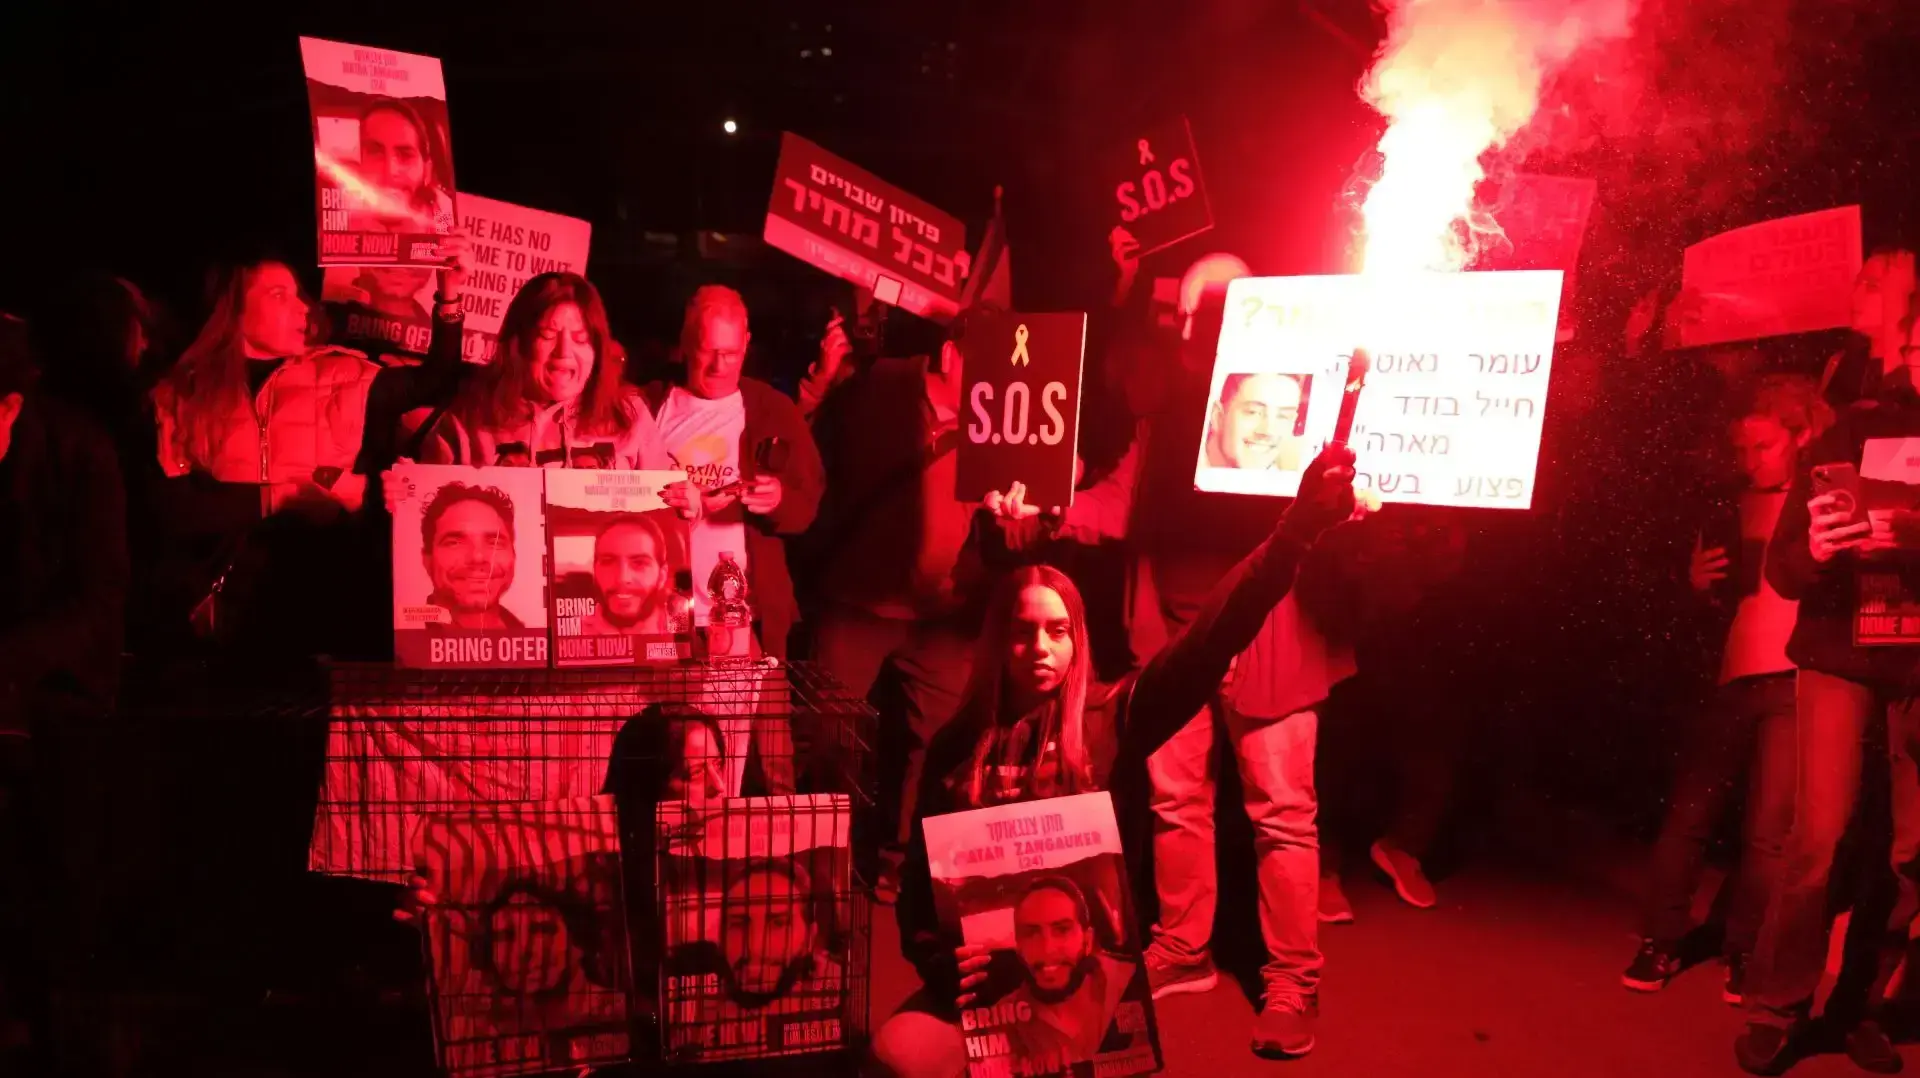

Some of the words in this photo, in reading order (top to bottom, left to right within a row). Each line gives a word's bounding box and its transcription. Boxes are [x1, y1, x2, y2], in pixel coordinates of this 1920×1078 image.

[810, 164, 884, 213] שבויים
[1116, 157, 1195, 222] S.O.S
[464, 216, 487, 238] HE
[490, 221, 524, 246] HAS
[528, 230, 551, 252] NO
[889, 204, 940, 243] פדיון
[505, 250, 526, 272] TO
[892, 226, 956, 288] בכל
[1468, 353, 1541, 375] עומר
[967, 380, 1068, 446] S.O.S
[1393, 395, 1461, 416] בודד
[1475, 389, 1535, 418] חייל
[1453, 474, 1523, 499] פצוע
[556, 597, 595, 617] BRING
[557, 616, 582, 637] HIM
[430, 637, 493, 663] BRING
[498, 636, 548, 662] OFER
[558, 639, 595, 658] HOME
[599, 637, 634, 657] NOW!
[1013, 830, 1102, 856] ZANGAUKER
[1018, 855, 1044, 869] (24)
[961, 1000, 1032, 1031] BRING
[965, 1032, 1011, 1058] HIM
